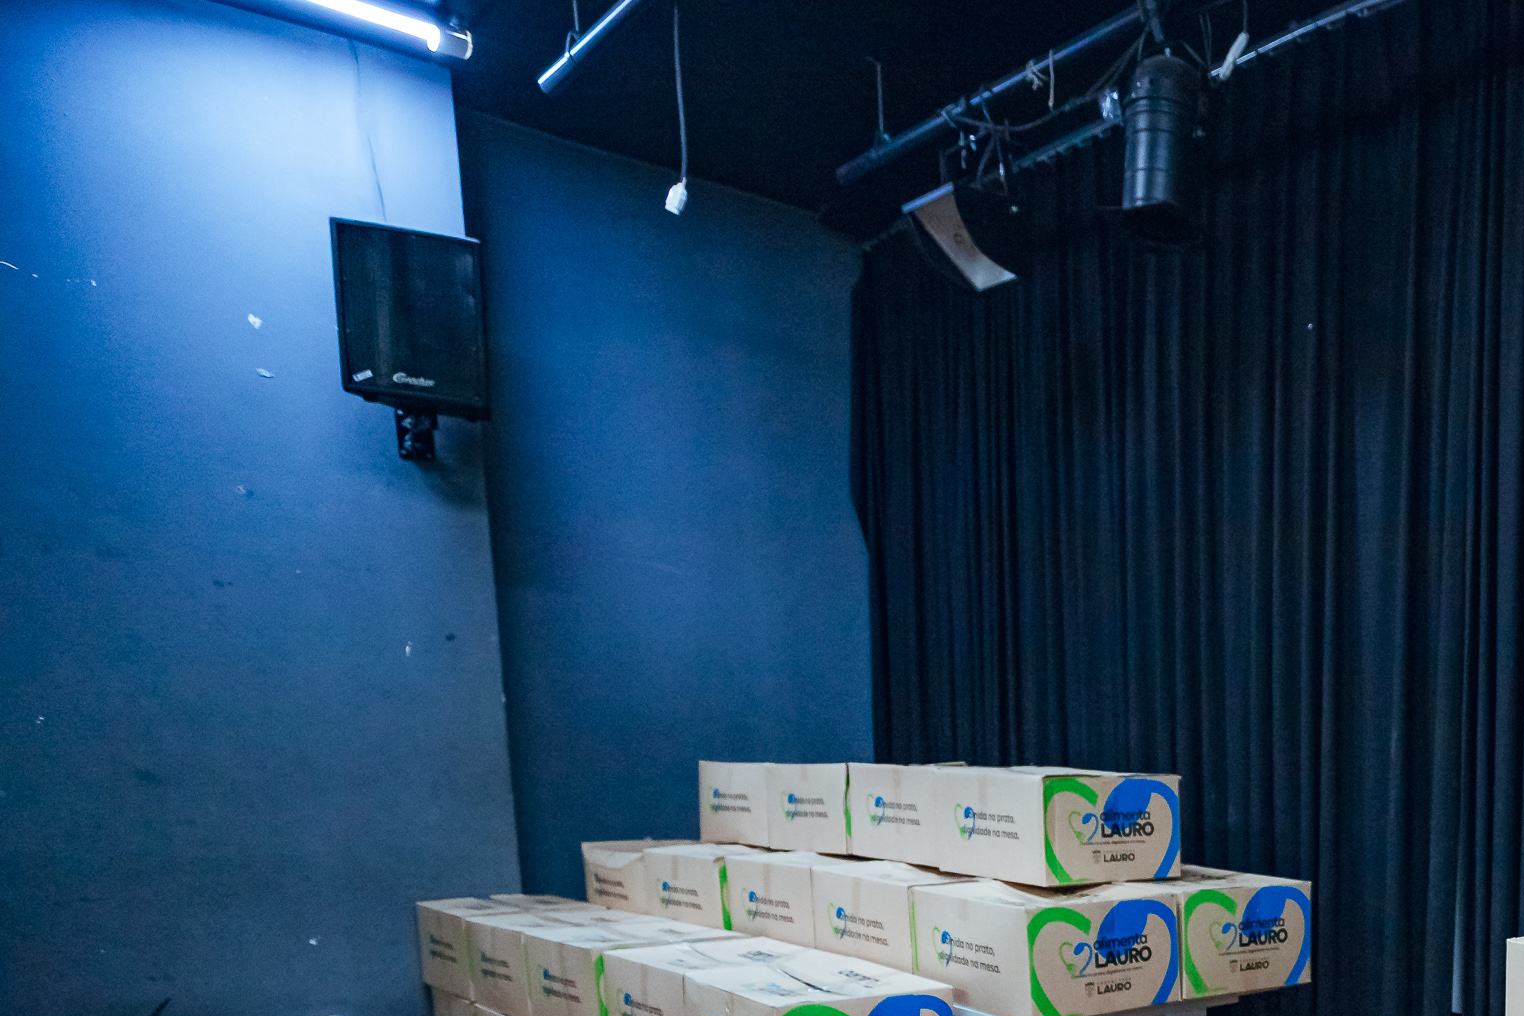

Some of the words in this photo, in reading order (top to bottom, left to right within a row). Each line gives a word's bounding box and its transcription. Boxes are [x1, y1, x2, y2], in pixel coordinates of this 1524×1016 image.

[1100, 808, 1151, 822] alimenta
[1100, 821, 1154, 838] LAURO
[1104, 853, 1136, 863] LAURO
[1238, 917, 1285, 931] alimenta
[1093, 934, 1148, 951] alimenta
[1239, 928, 1288, 948] LAURO
[1094, 945, 1152, 968] LAURO
[1240, 960, 1270, 972] LAURO
[1097, 981, 1132, 995] LAURO
